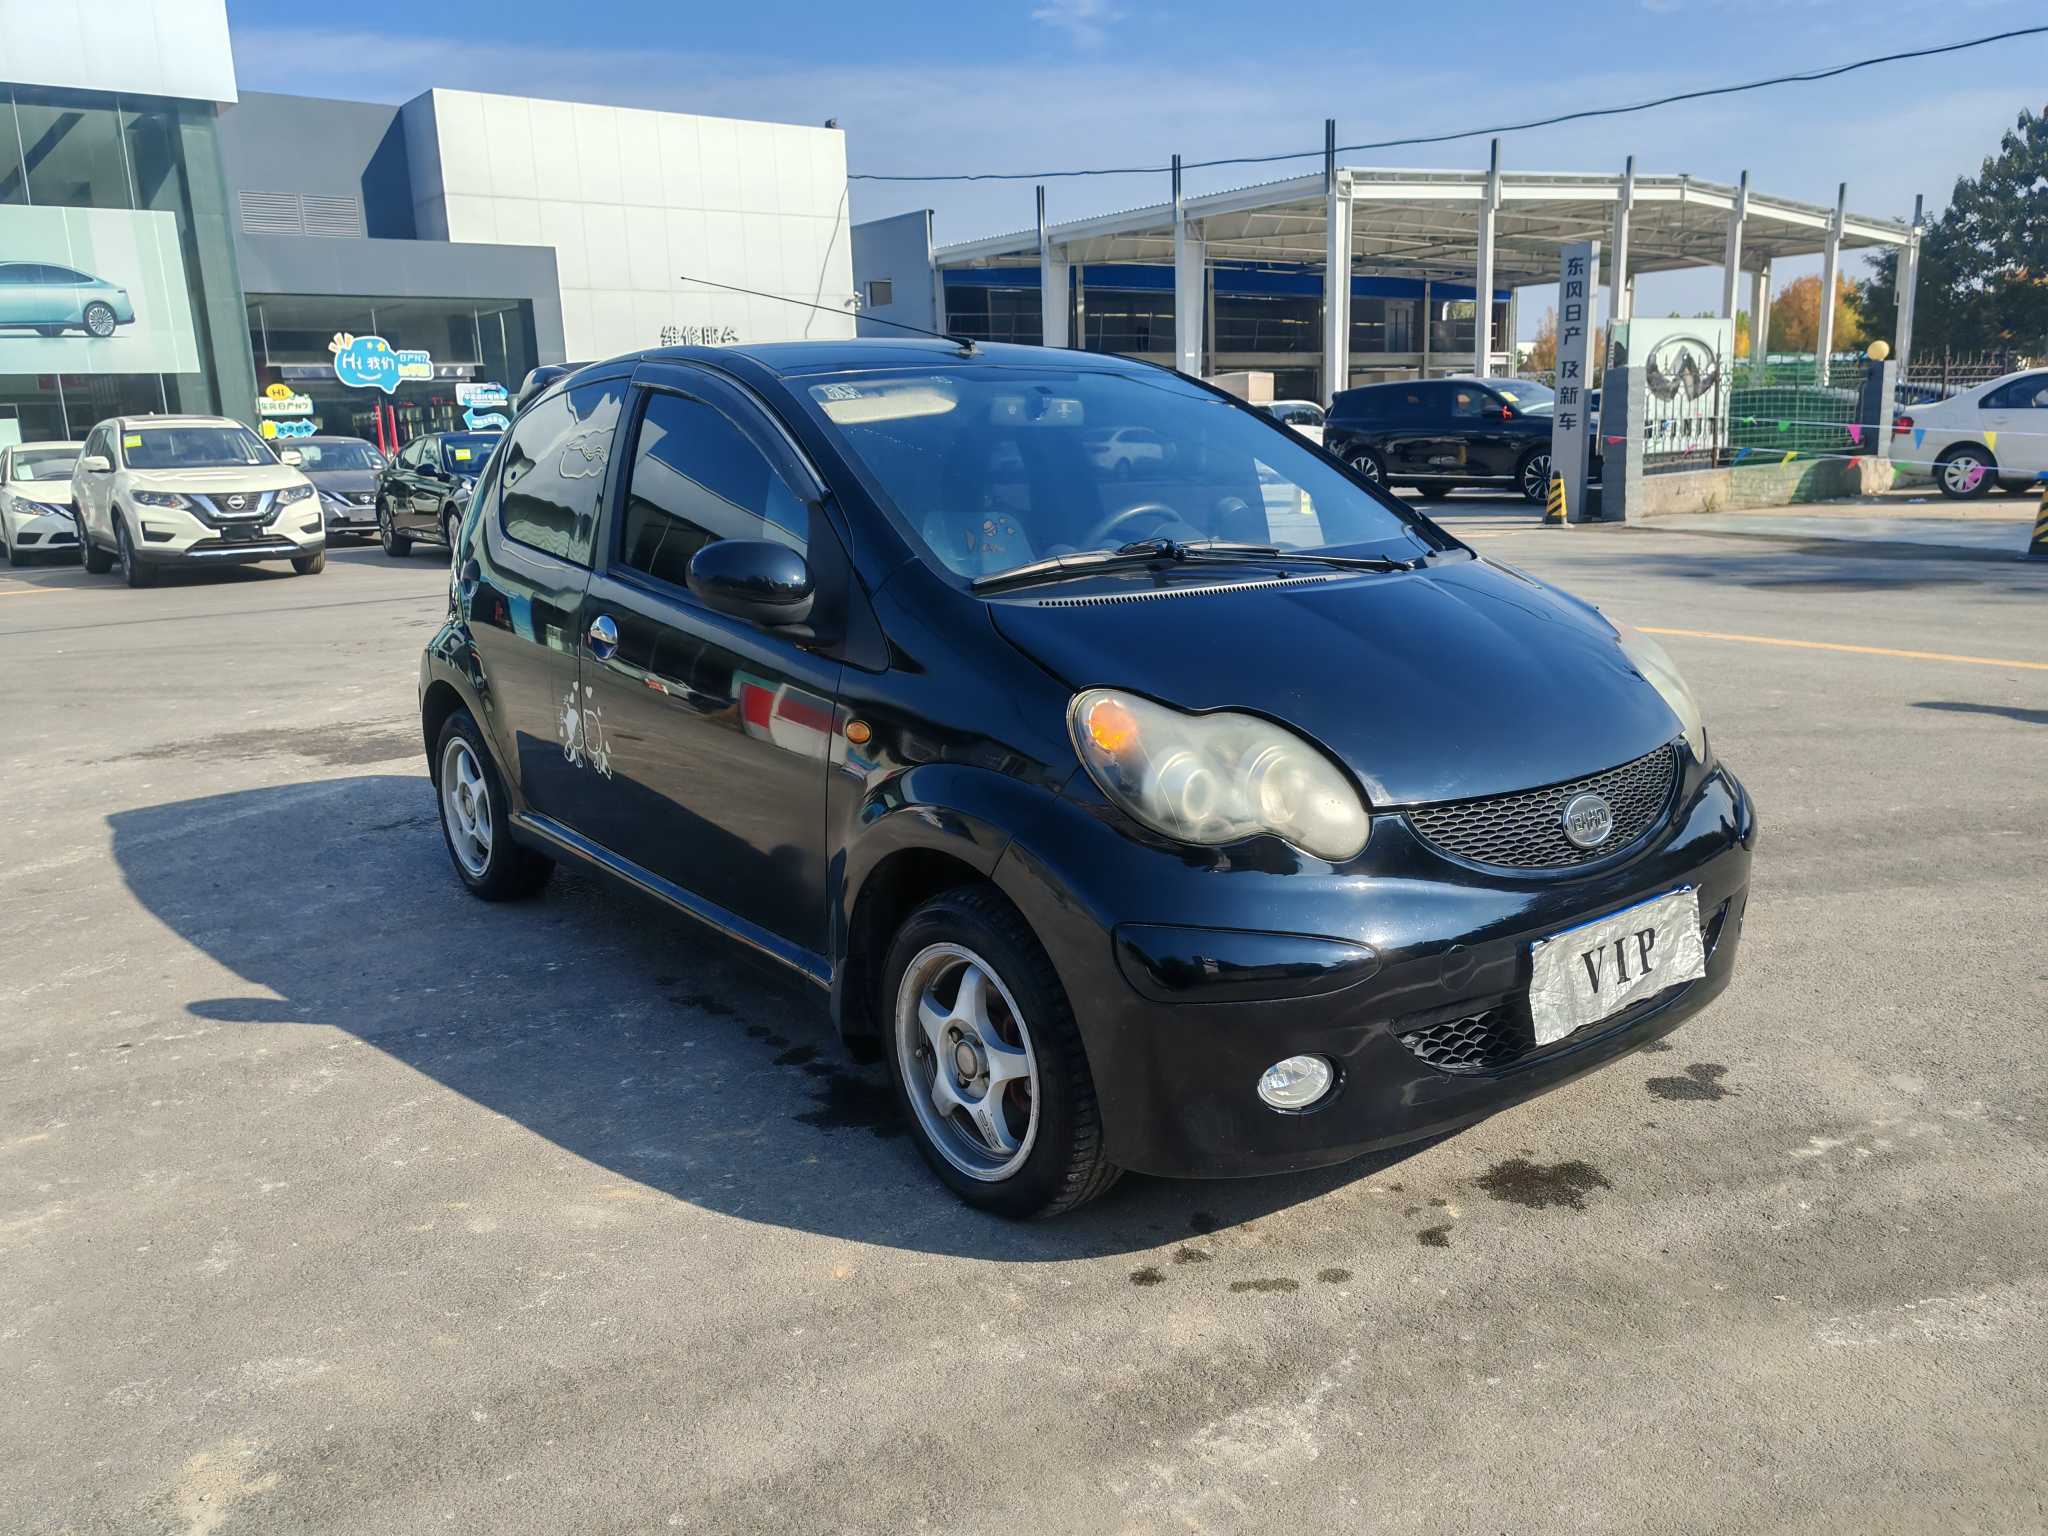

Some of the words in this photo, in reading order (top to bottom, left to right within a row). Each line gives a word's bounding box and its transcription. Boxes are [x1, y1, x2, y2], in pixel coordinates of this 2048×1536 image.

[1564, 257, 1584, 346] 东风日产
[1581, 927, 1656, 994] VIP
